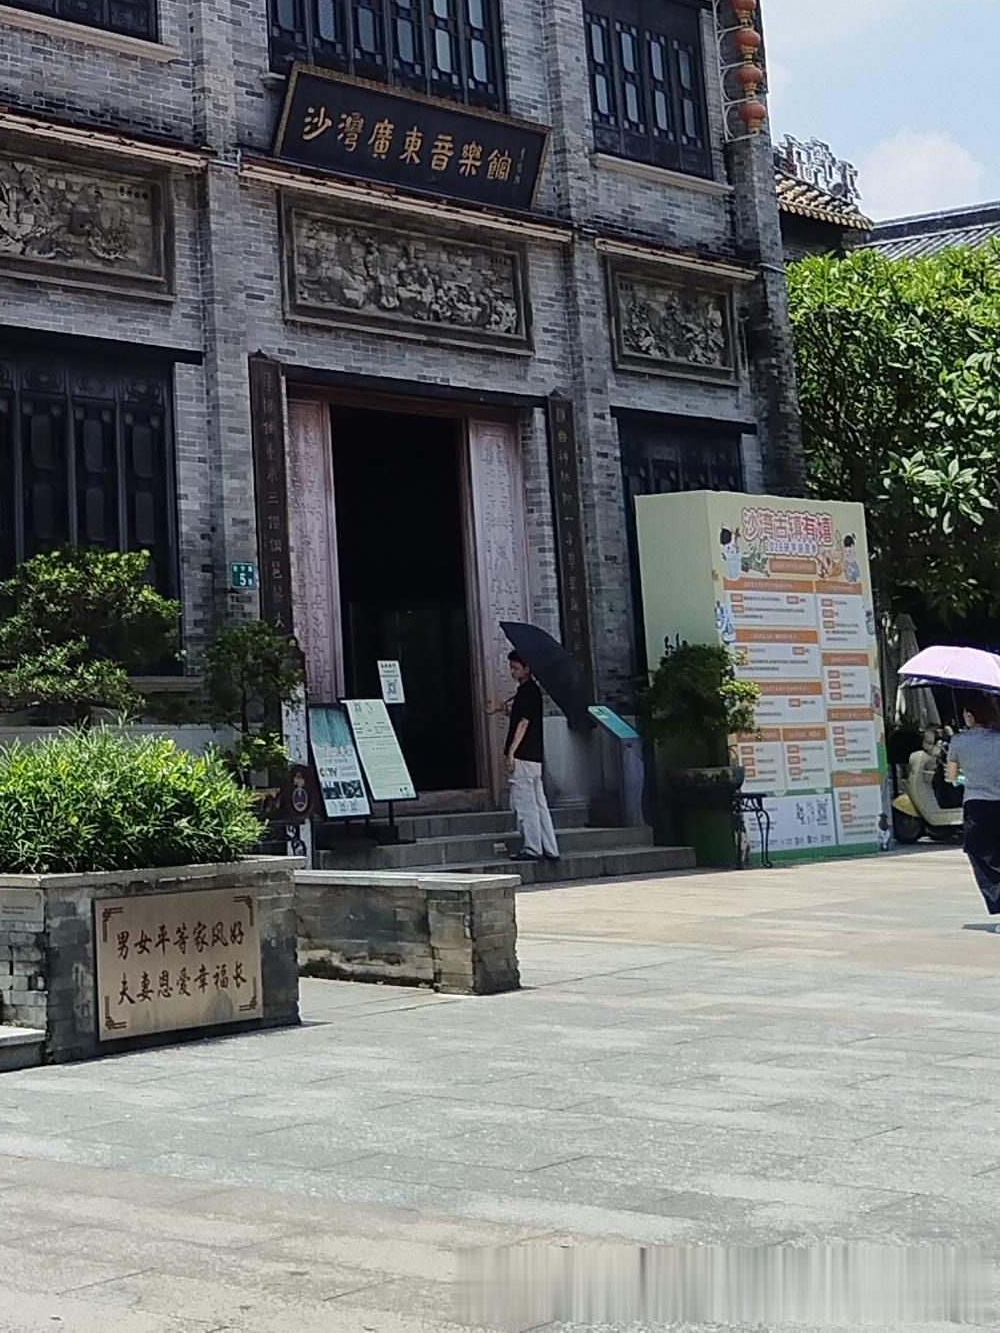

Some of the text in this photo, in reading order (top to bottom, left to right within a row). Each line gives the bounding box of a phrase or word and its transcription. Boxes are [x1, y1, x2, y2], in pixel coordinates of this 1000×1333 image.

[302, 106, 511, 181] 沙灣廣東音樂館
[116, 921, 244, 960] 男女平等家风好
[117, 960, 247, 1006] 夫妻恩爱幸福长
